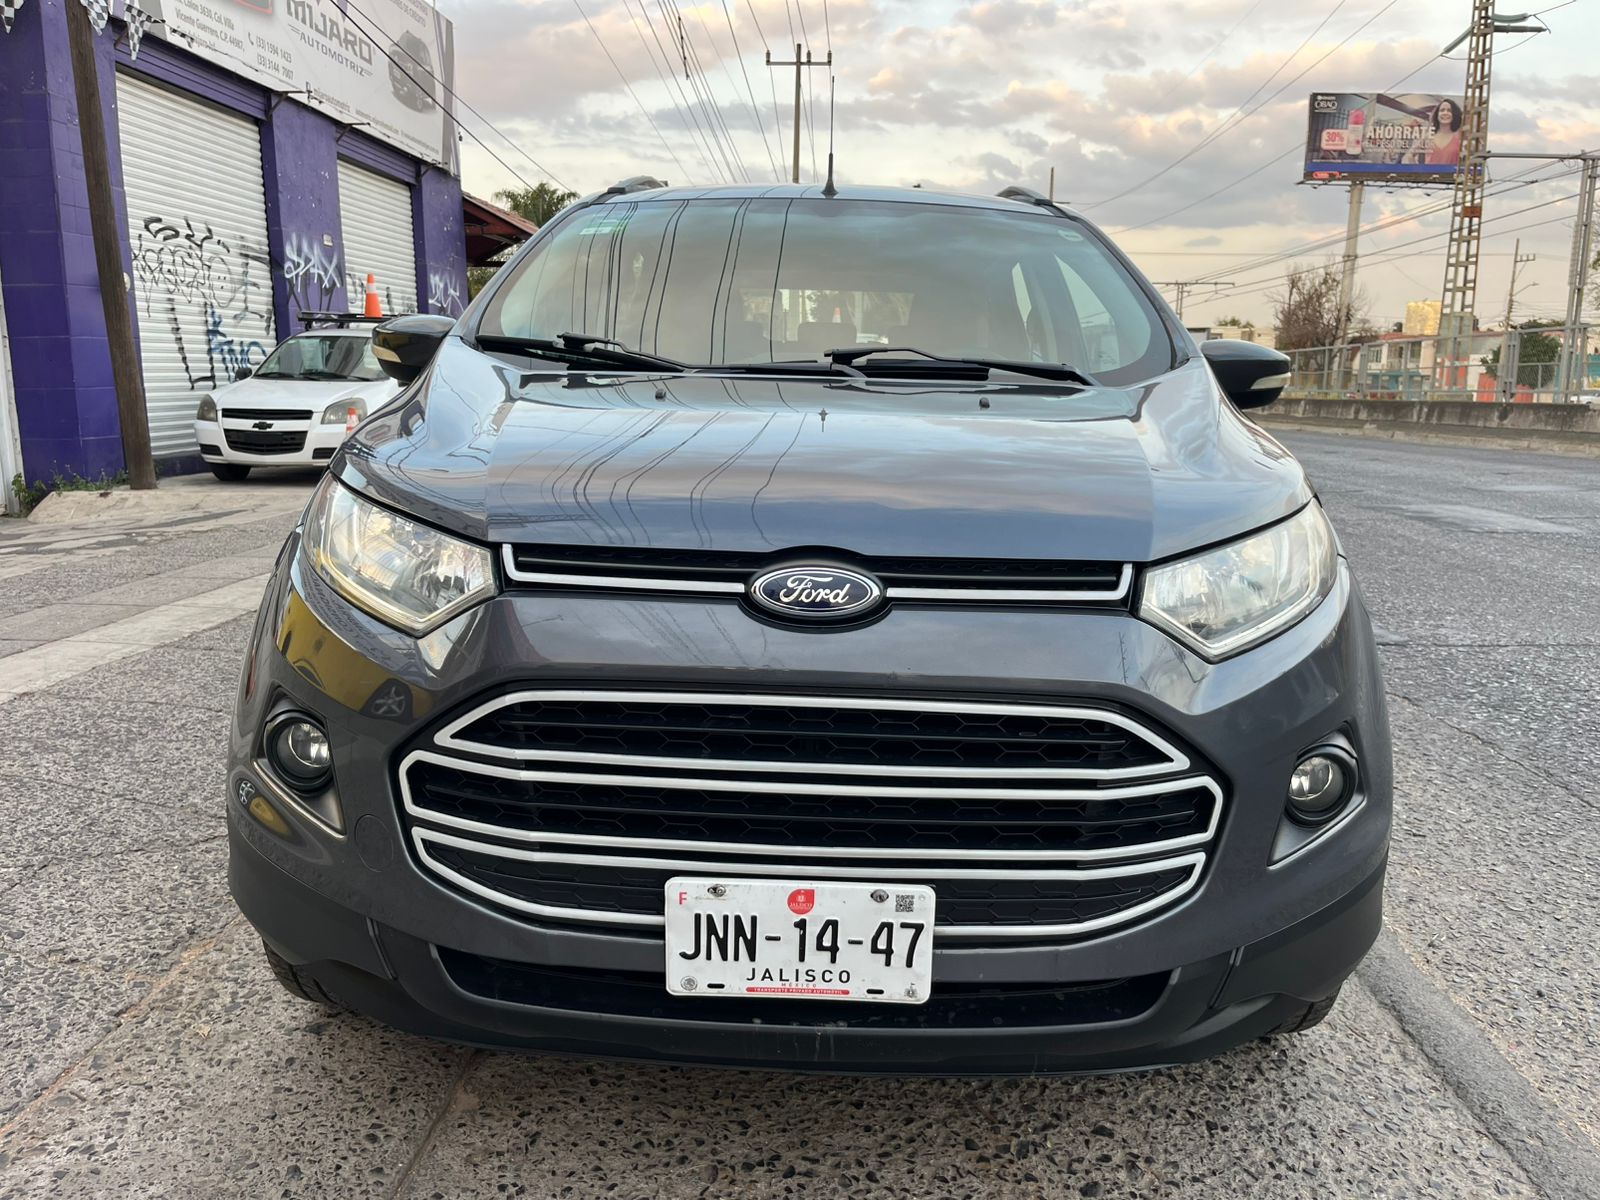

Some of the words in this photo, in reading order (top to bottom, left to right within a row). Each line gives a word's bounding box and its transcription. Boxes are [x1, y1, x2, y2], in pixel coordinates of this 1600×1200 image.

[287, 0, 372, 66] MIJARO
[300, 31, 365, 77] AUTOMOTRIZ
[1325, 131, 1345, 142] 30%
[780, 575, 851, 603] Ford
[679, 892, 687, 904] F
[679, 912, 925, 969] JNN-14-47
[746, 967, 851, 983] JALISCO
